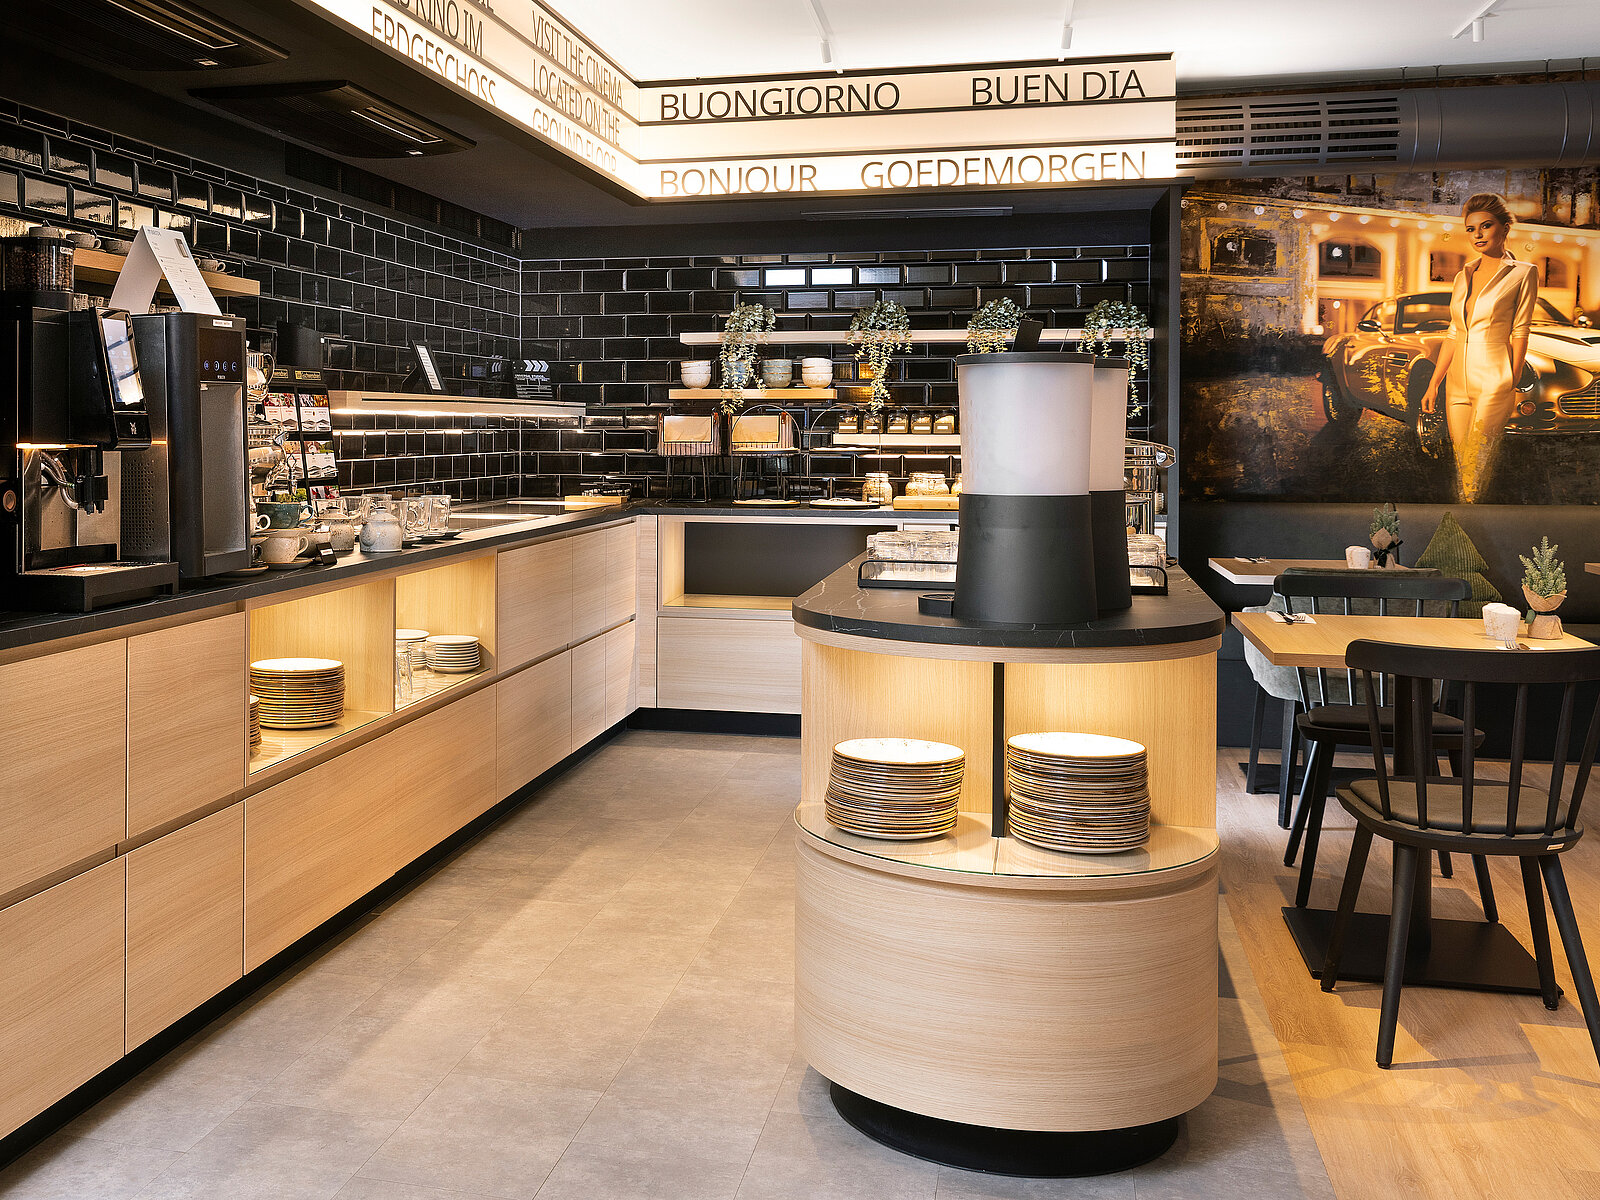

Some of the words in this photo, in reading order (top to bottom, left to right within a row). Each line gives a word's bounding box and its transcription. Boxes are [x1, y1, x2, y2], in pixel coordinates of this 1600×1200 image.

[372, 6, 496, 106] ERDGESCHOSS
[463, 9, 483, 58] IM
[532, 10, 561, 61] VISIT
[563, 35, 584, 80] THE
[586, 55, 622, 108] CINEMA
[534, 59, 582, 120] LOCATED
[585, 97, 601, 133] ON
[603, 108, 620, 147] THE
[661, 81, 900, 120] BUONGIORNO
[972, 72, 1068, 106] BUEN
[1082, 69, 1146, 100] DIA
[661, 164, 817, 195] BONJOUR
[861, 151, 1146, 188] GOEDEMORGEN
